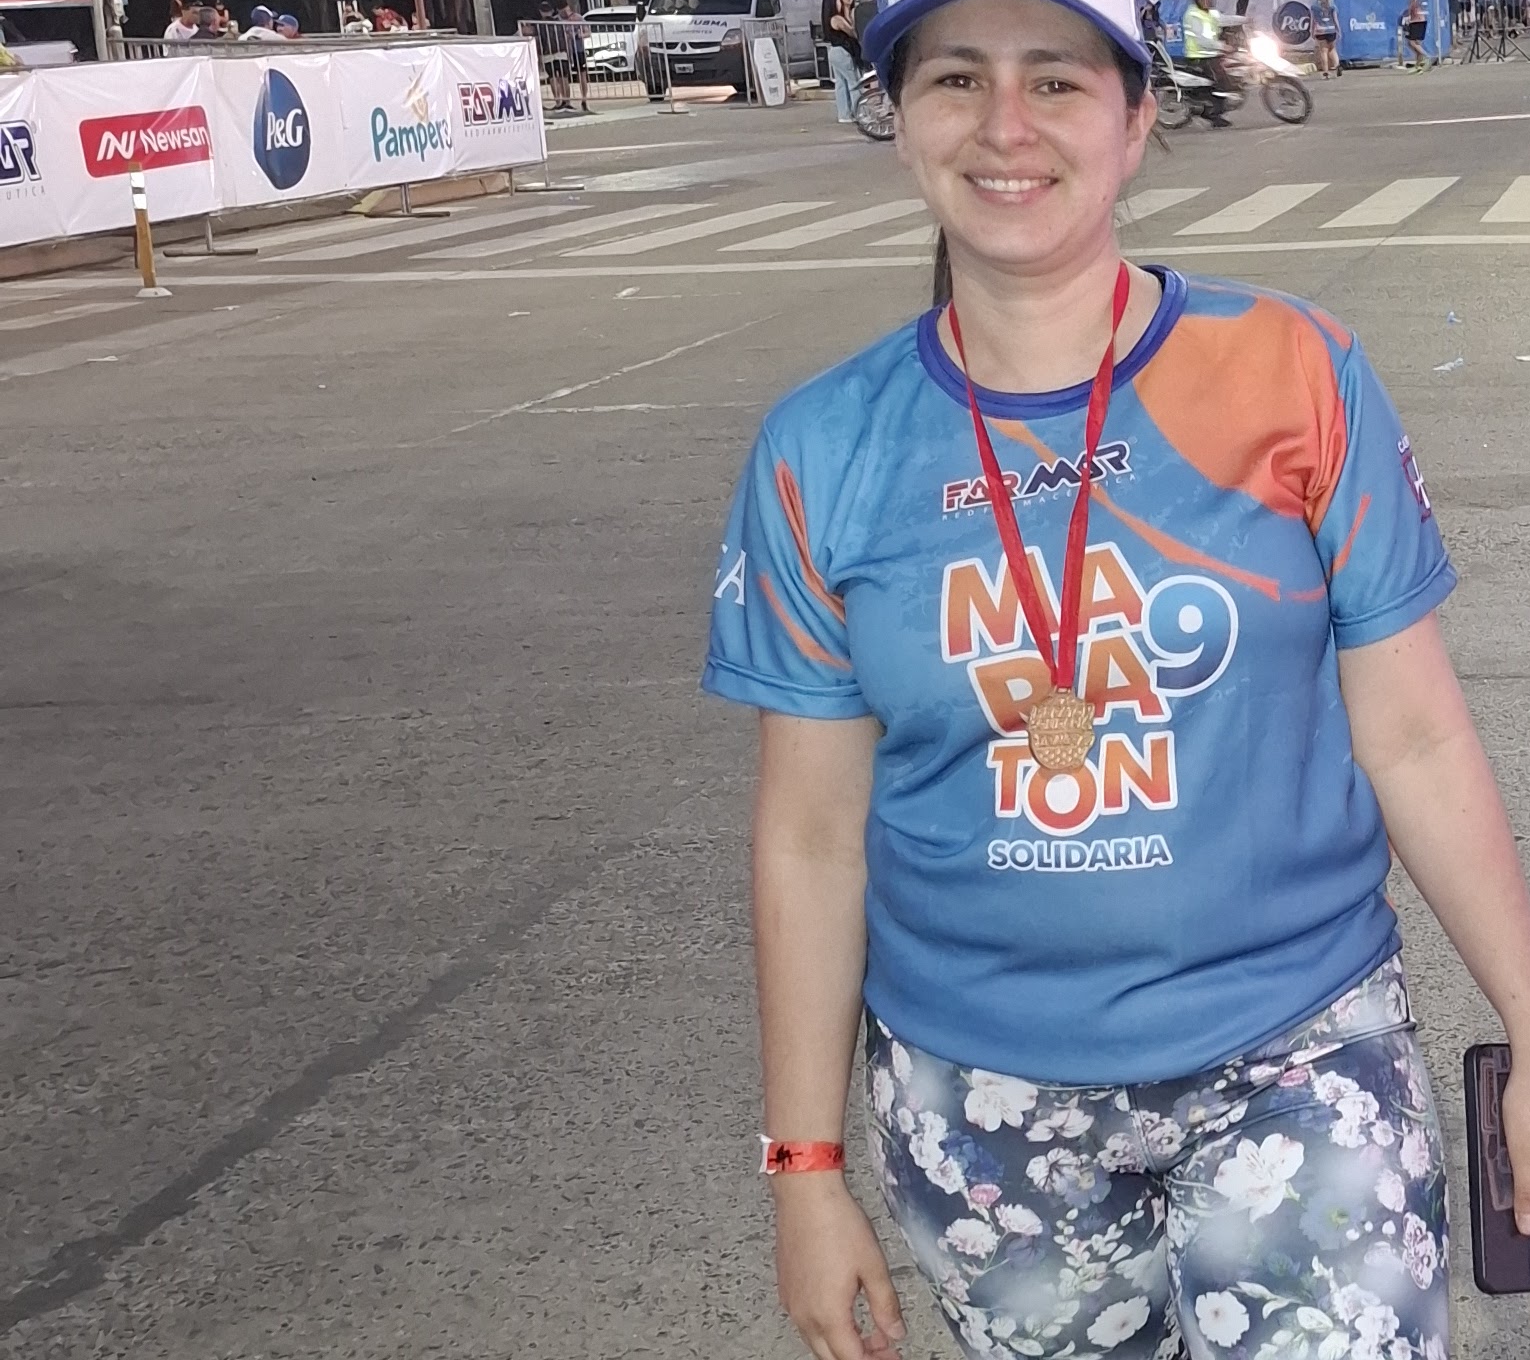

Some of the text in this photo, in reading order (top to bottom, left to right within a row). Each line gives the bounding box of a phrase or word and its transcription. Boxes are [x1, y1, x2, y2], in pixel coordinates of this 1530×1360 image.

[1280, 15, 1310, 31] P&G
[140, 125, 214, 156] Newsan
[265, 108, 304, 151] P&G
[941, 541, 1146, 663] MA
[1142, 574, 1239, 698] 9
[987, 835, 1173, 872] SOLIDARIA
